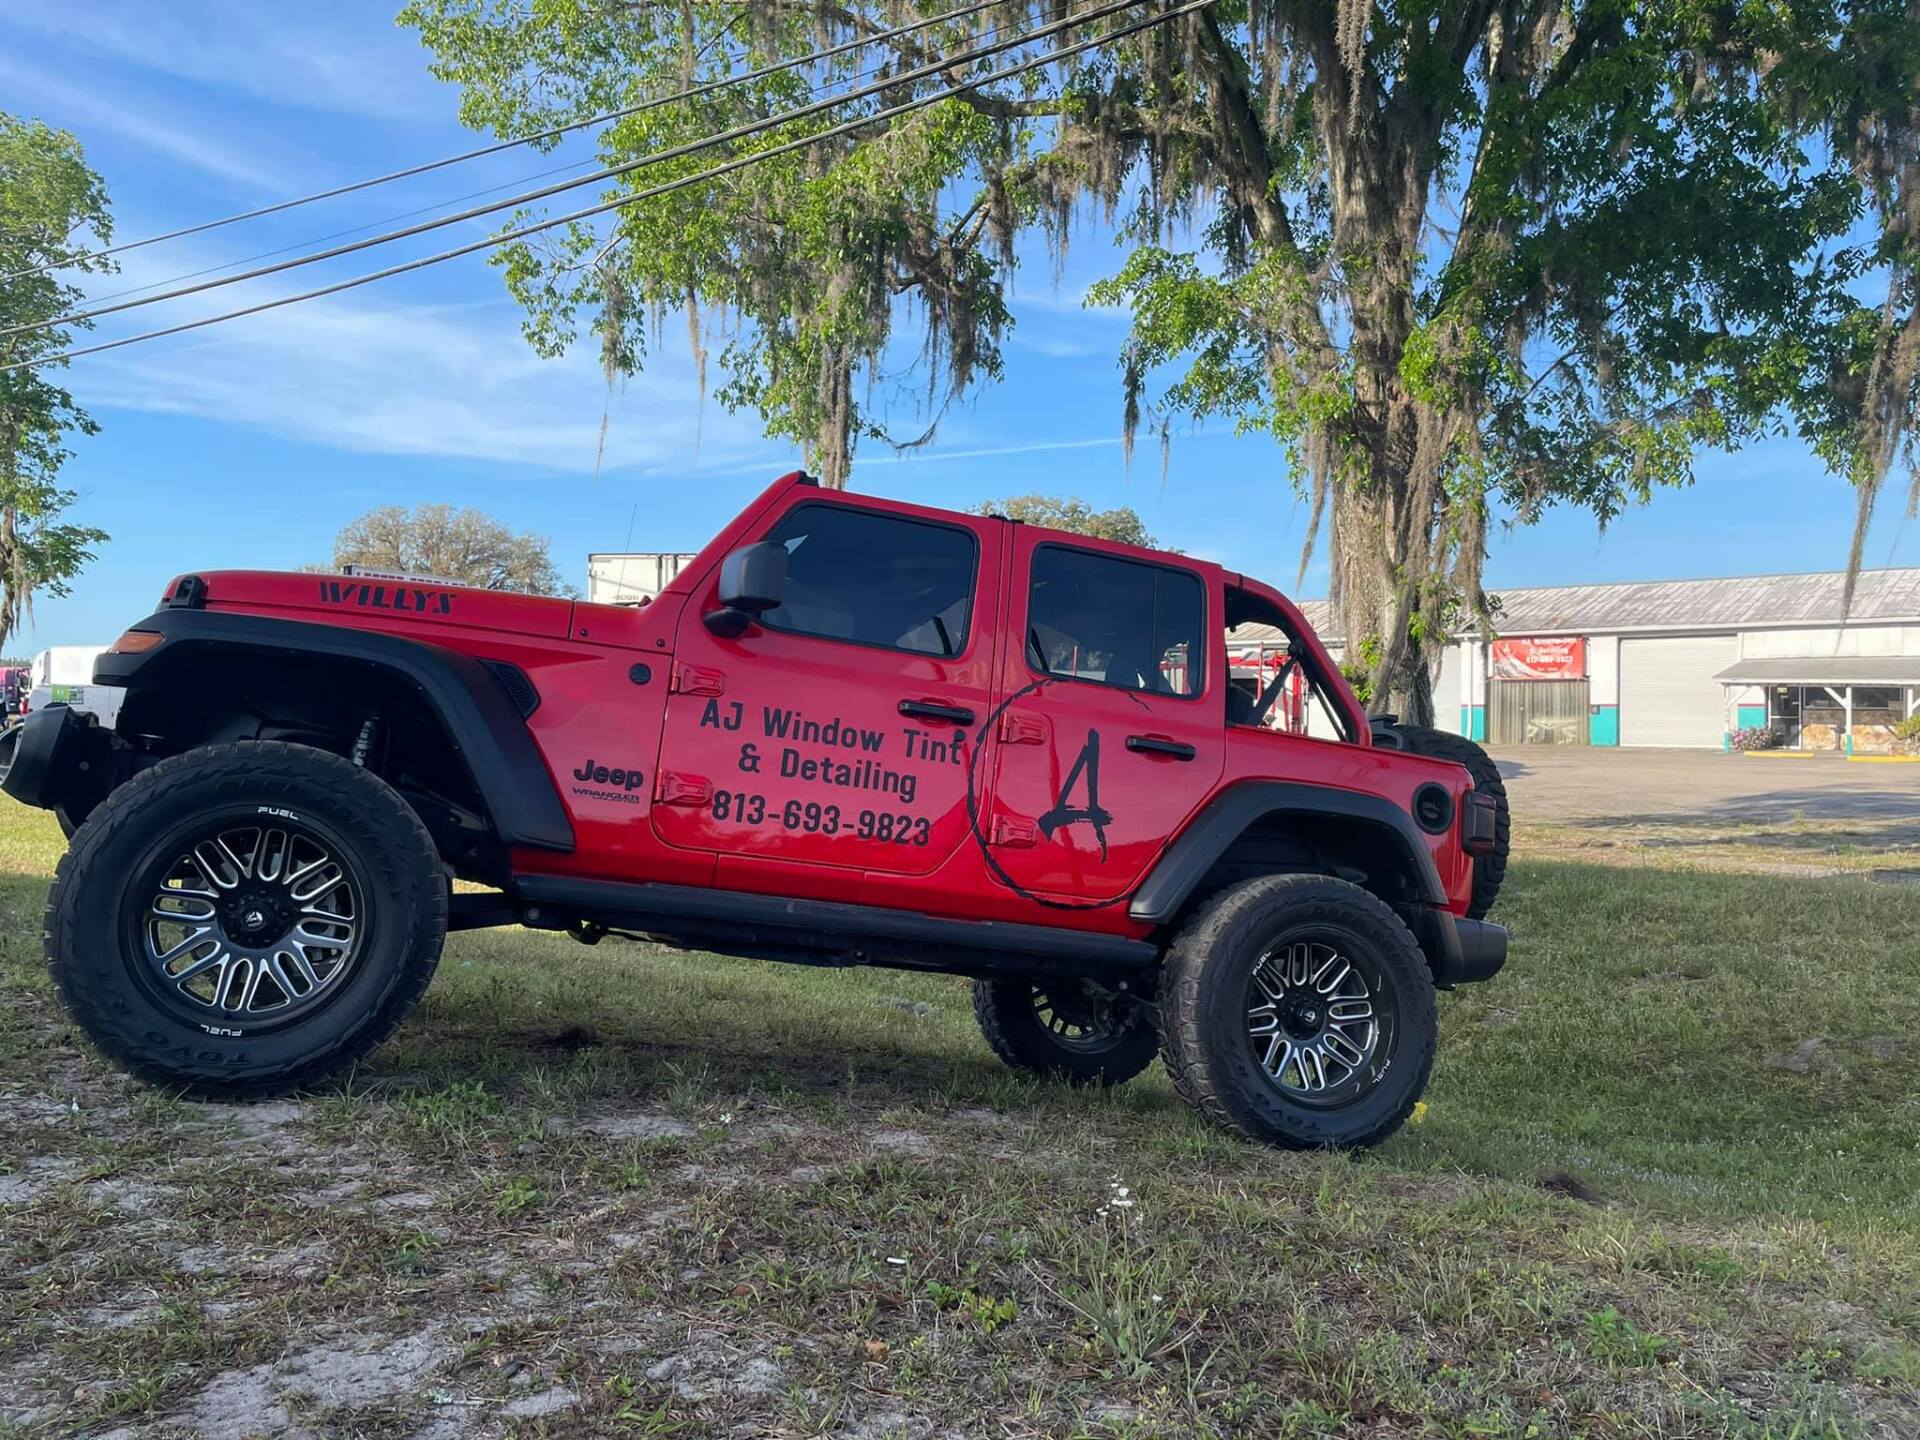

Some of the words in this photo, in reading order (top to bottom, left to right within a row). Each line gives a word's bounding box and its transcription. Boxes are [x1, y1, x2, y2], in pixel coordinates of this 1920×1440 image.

[319, 581, 457, 614] WILLYS
[700, 698, 743, 732] AJ
[763, 706, 885, 753] Window
[903, 728, 962, 765] Tint
[573, 759, 644, 791] Jeep
[737, 743, 761, 773] &
[780, 748, 917, 804] Detailing
[572, 787, 640, 802] WRANGLER
[257, 805, 299, 820] FUEL
[712, 790, 931, 847] 813-693-9823
[1252, 949, 1272, 976] FUEL
[199, 1023, 243, 1038] FUEL
[1371, 1058, 1391, 1085] FUEL
